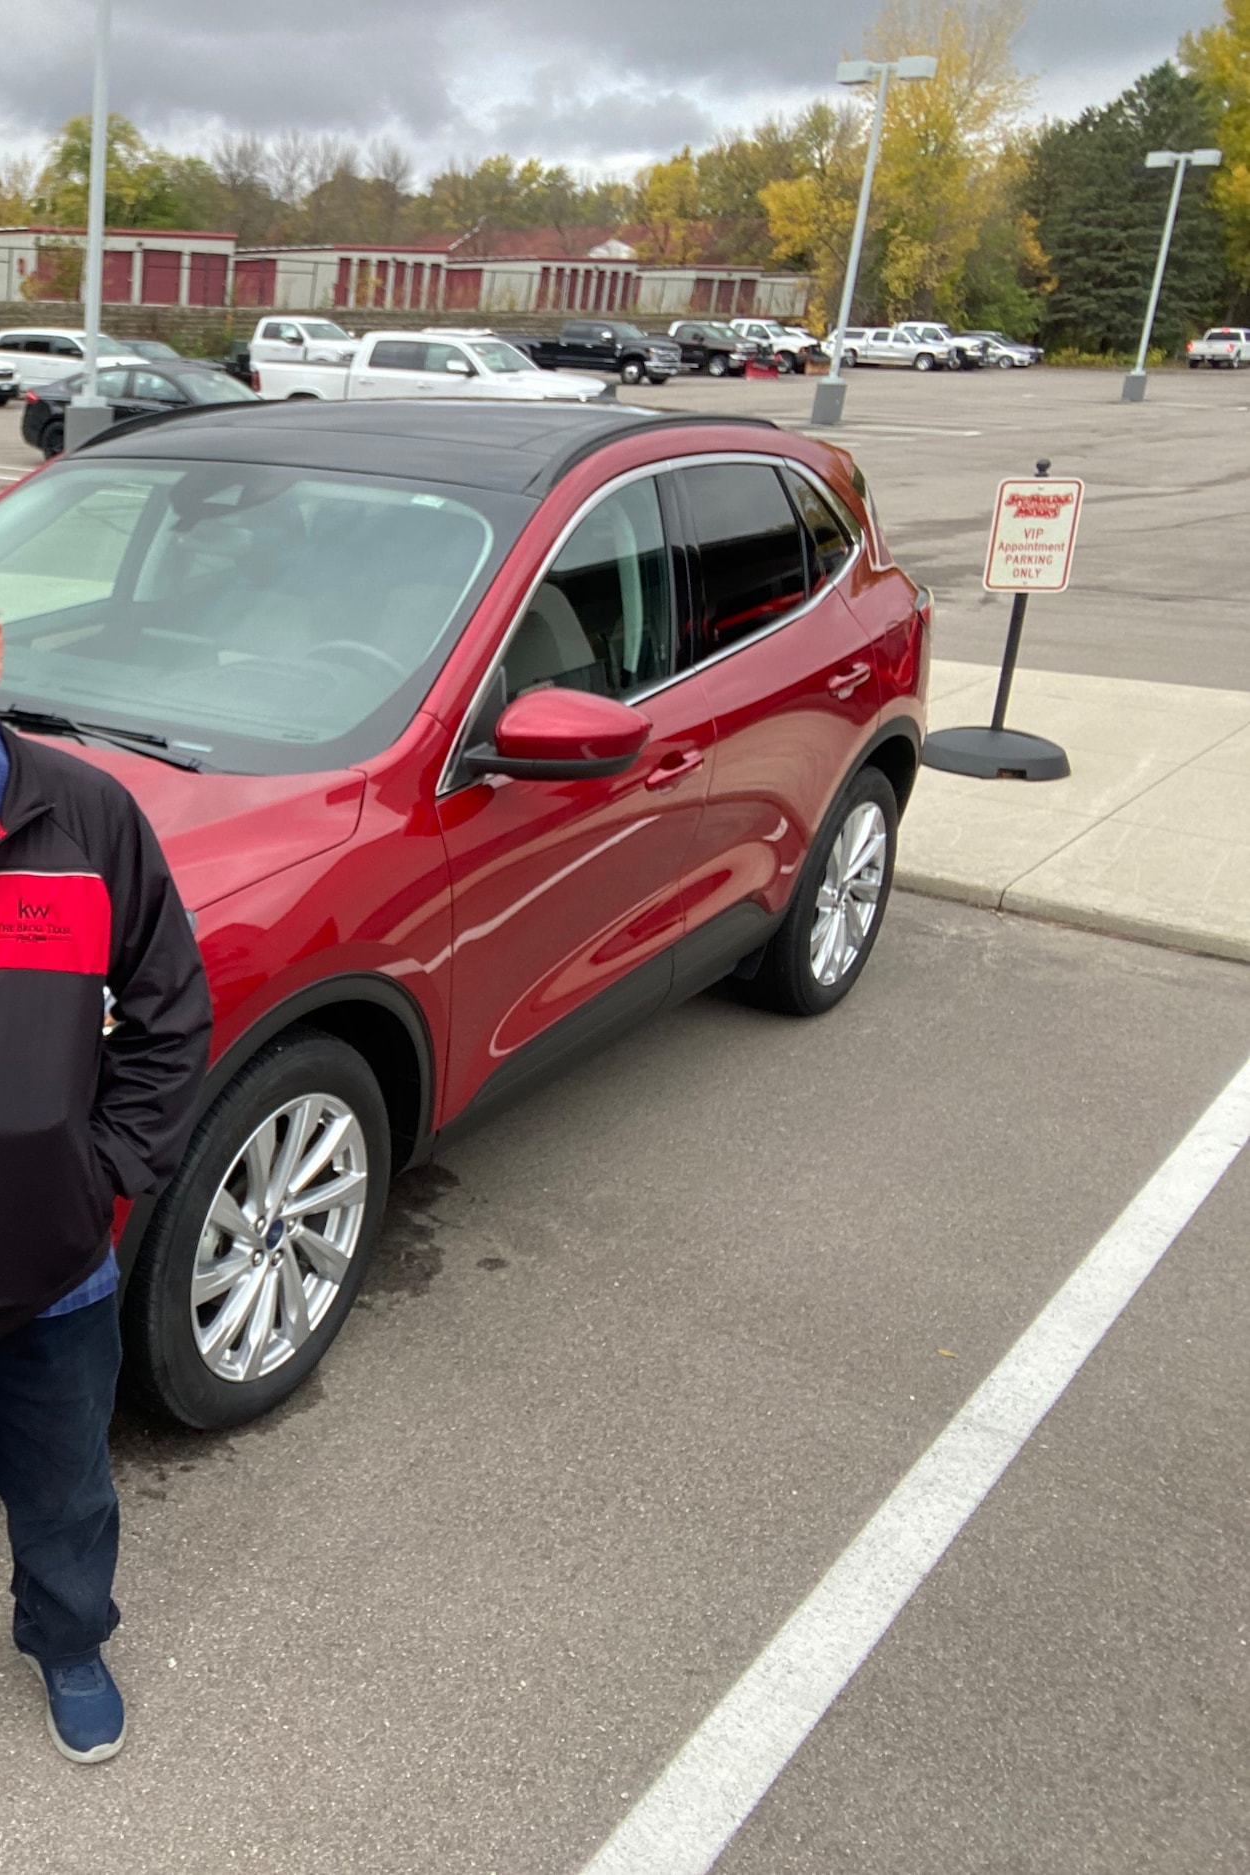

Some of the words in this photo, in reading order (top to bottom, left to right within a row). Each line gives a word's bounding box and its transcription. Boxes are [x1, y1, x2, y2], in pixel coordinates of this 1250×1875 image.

[1024, 528, 1044, 540] VIP
[998, 541, 1065, 553] Appointment
[1005, 554, 1053, 566] PARKING
[1013, 568, 1042, 579] ONLY
[18, 897, 50, 919] kw
